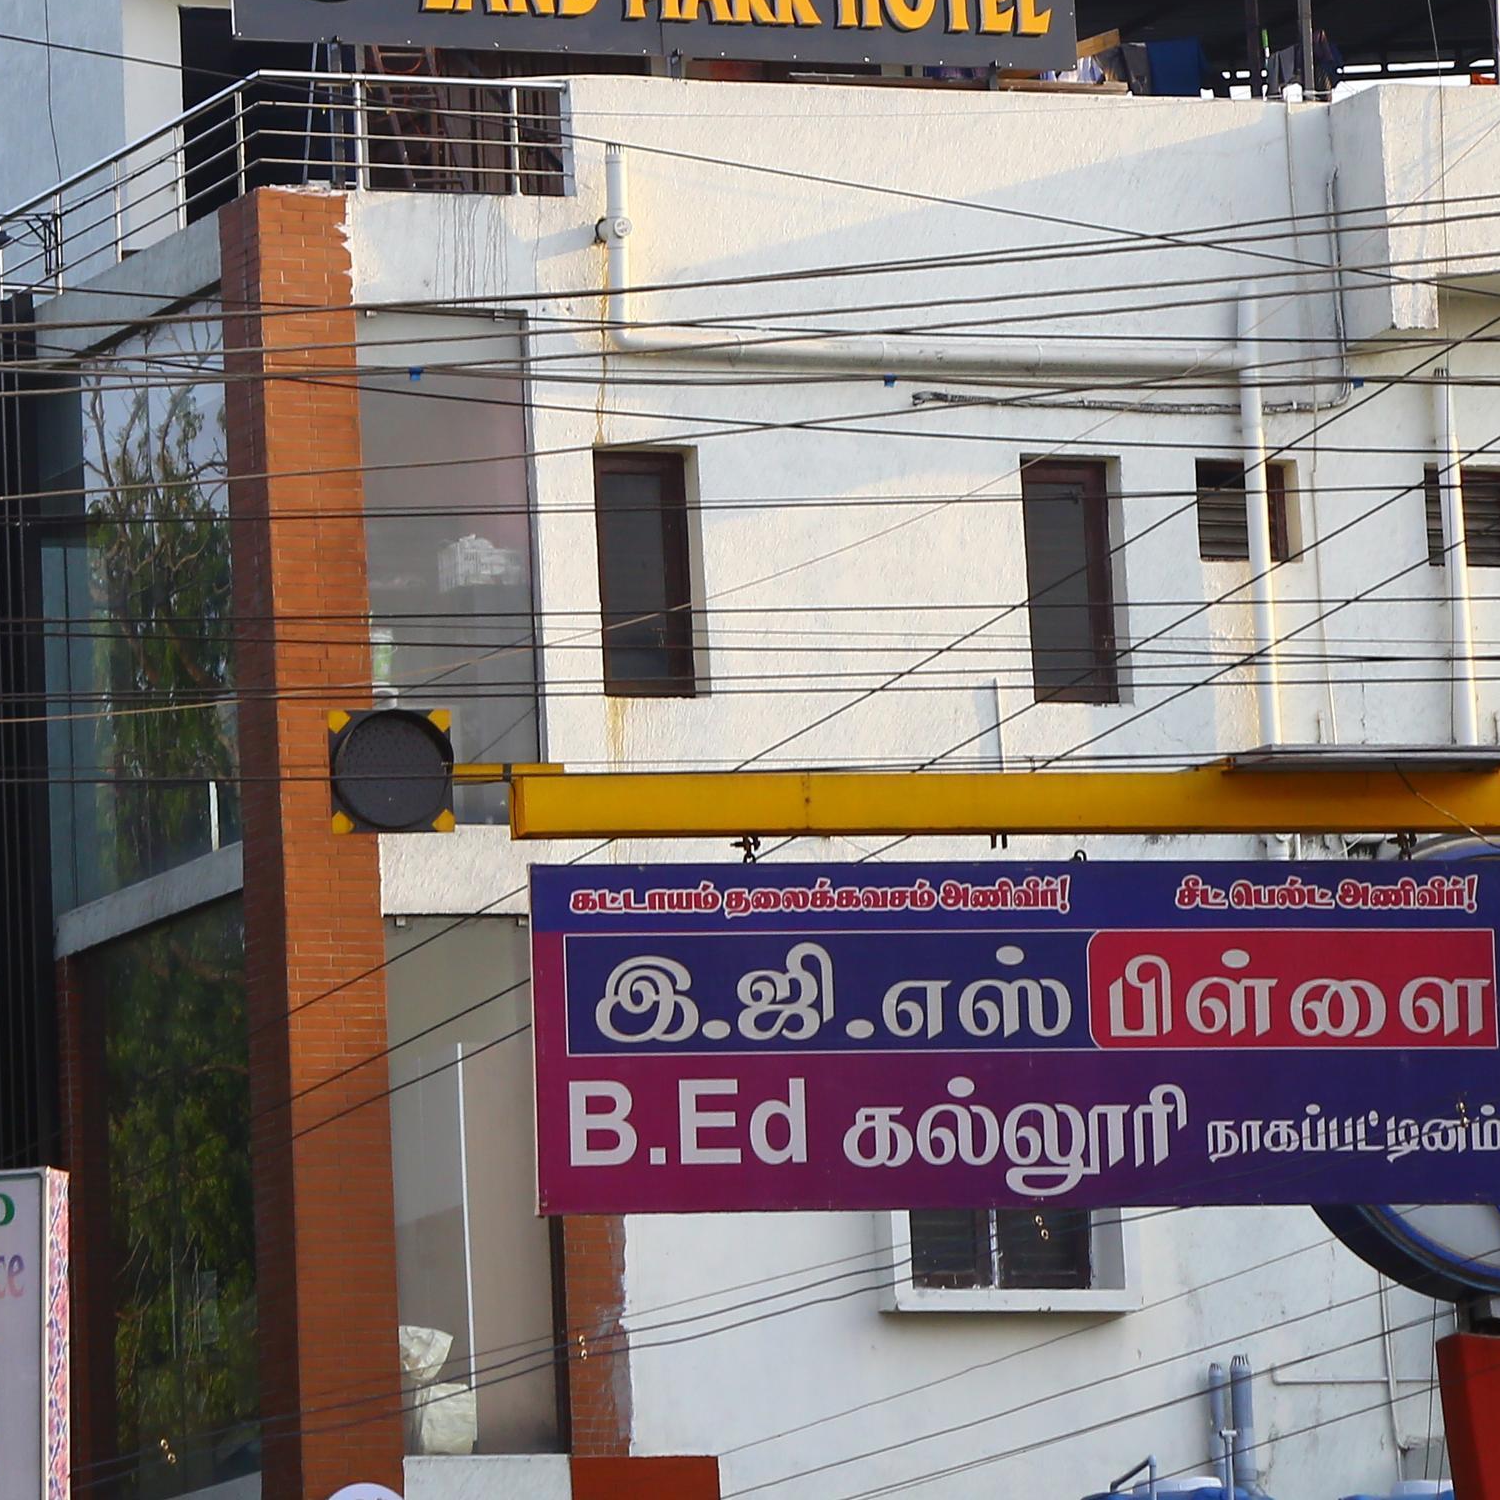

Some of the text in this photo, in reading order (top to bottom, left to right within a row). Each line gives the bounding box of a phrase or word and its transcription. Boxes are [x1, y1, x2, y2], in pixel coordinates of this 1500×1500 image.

[570, 874, 1071, 919] கட்டாயம் தலைக்கவசம் அணிவீர்!
[1175, 874, 1478, 913] சீட் பெல்ட் அணிவீர்!
[1109, 949, 1491, 1037] பிள்ளை
[569, 1077, 808, 1168] B.Ed
[843, 1076, 1187, 1197] கல்லூரி
